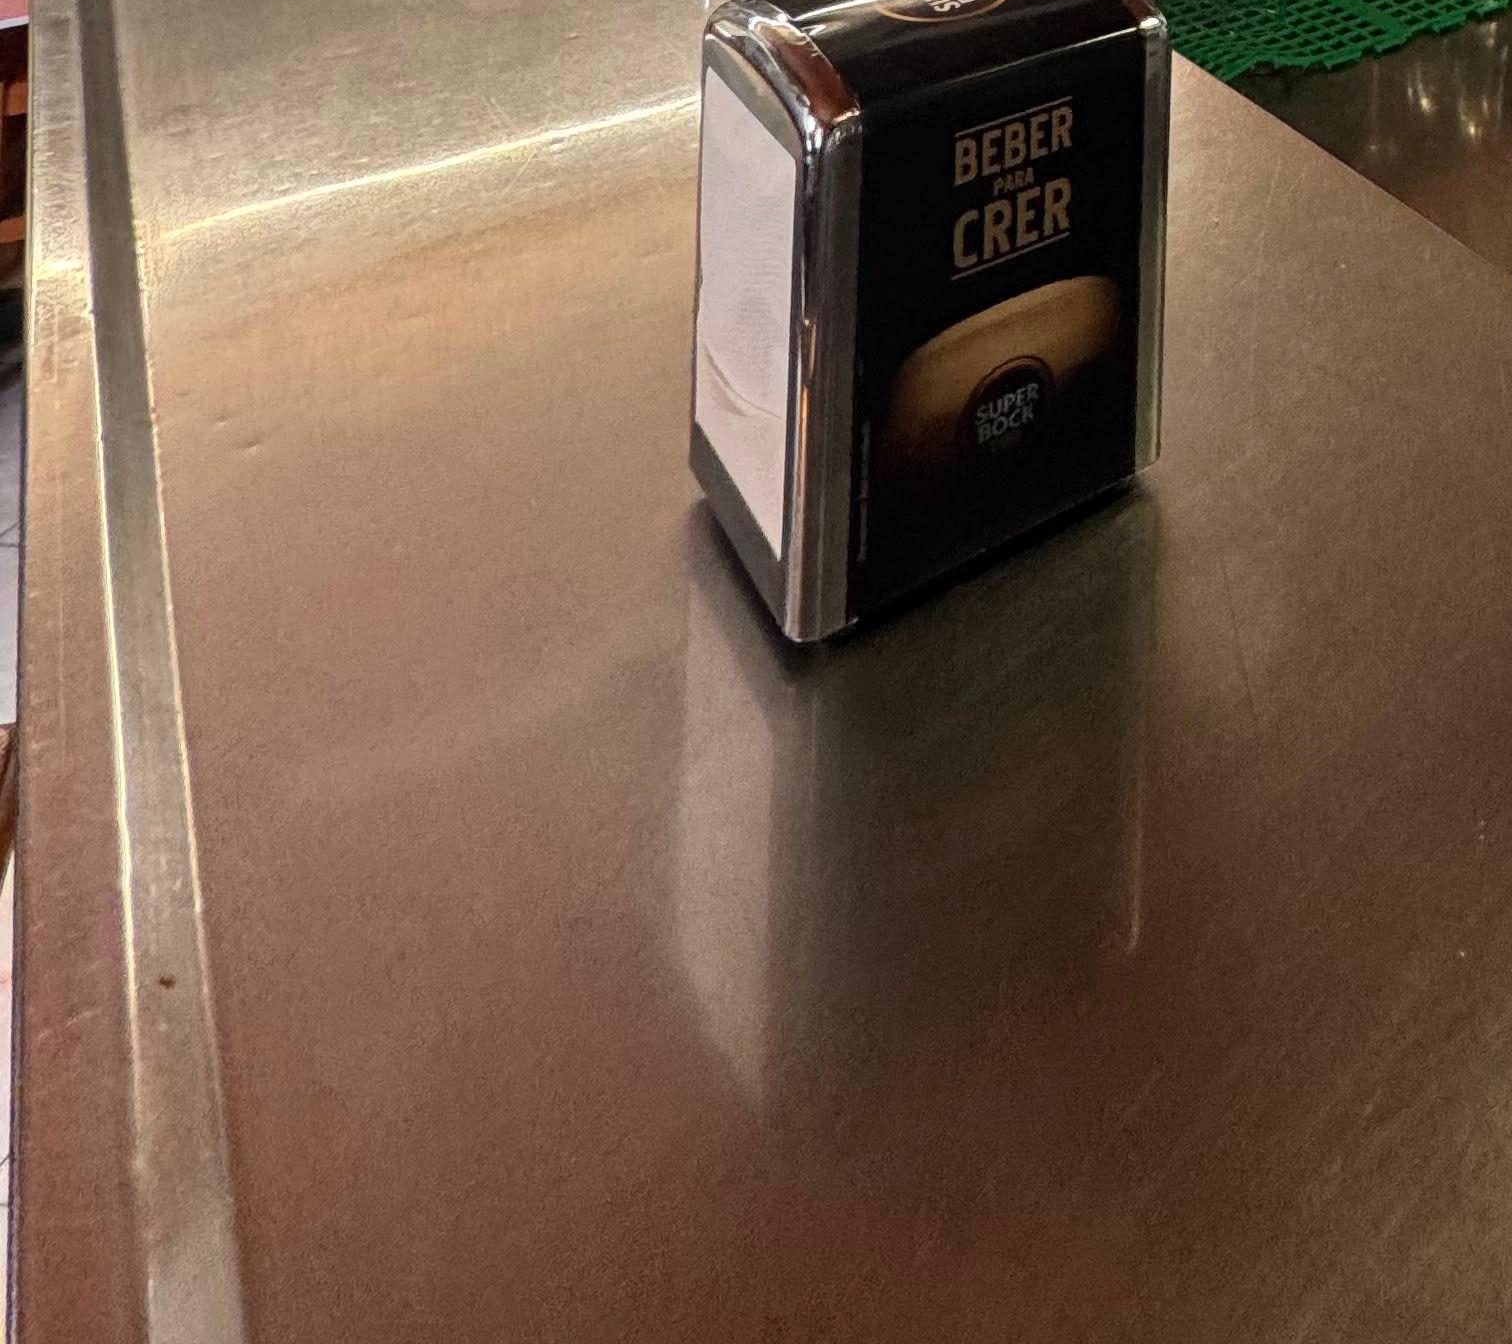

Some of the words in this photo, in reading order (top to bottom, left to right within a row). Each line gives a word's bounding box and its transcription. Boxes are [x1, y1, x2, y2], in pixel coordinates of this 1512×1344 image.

[954, 105, 1073, 186] BEBER
[992, 167, 1035, 197] PARA
[953, 177, 1072, 269] CRER
[975, 383, 1039, 426] SUPER
[977, 402, 1034, 445] BOCK
